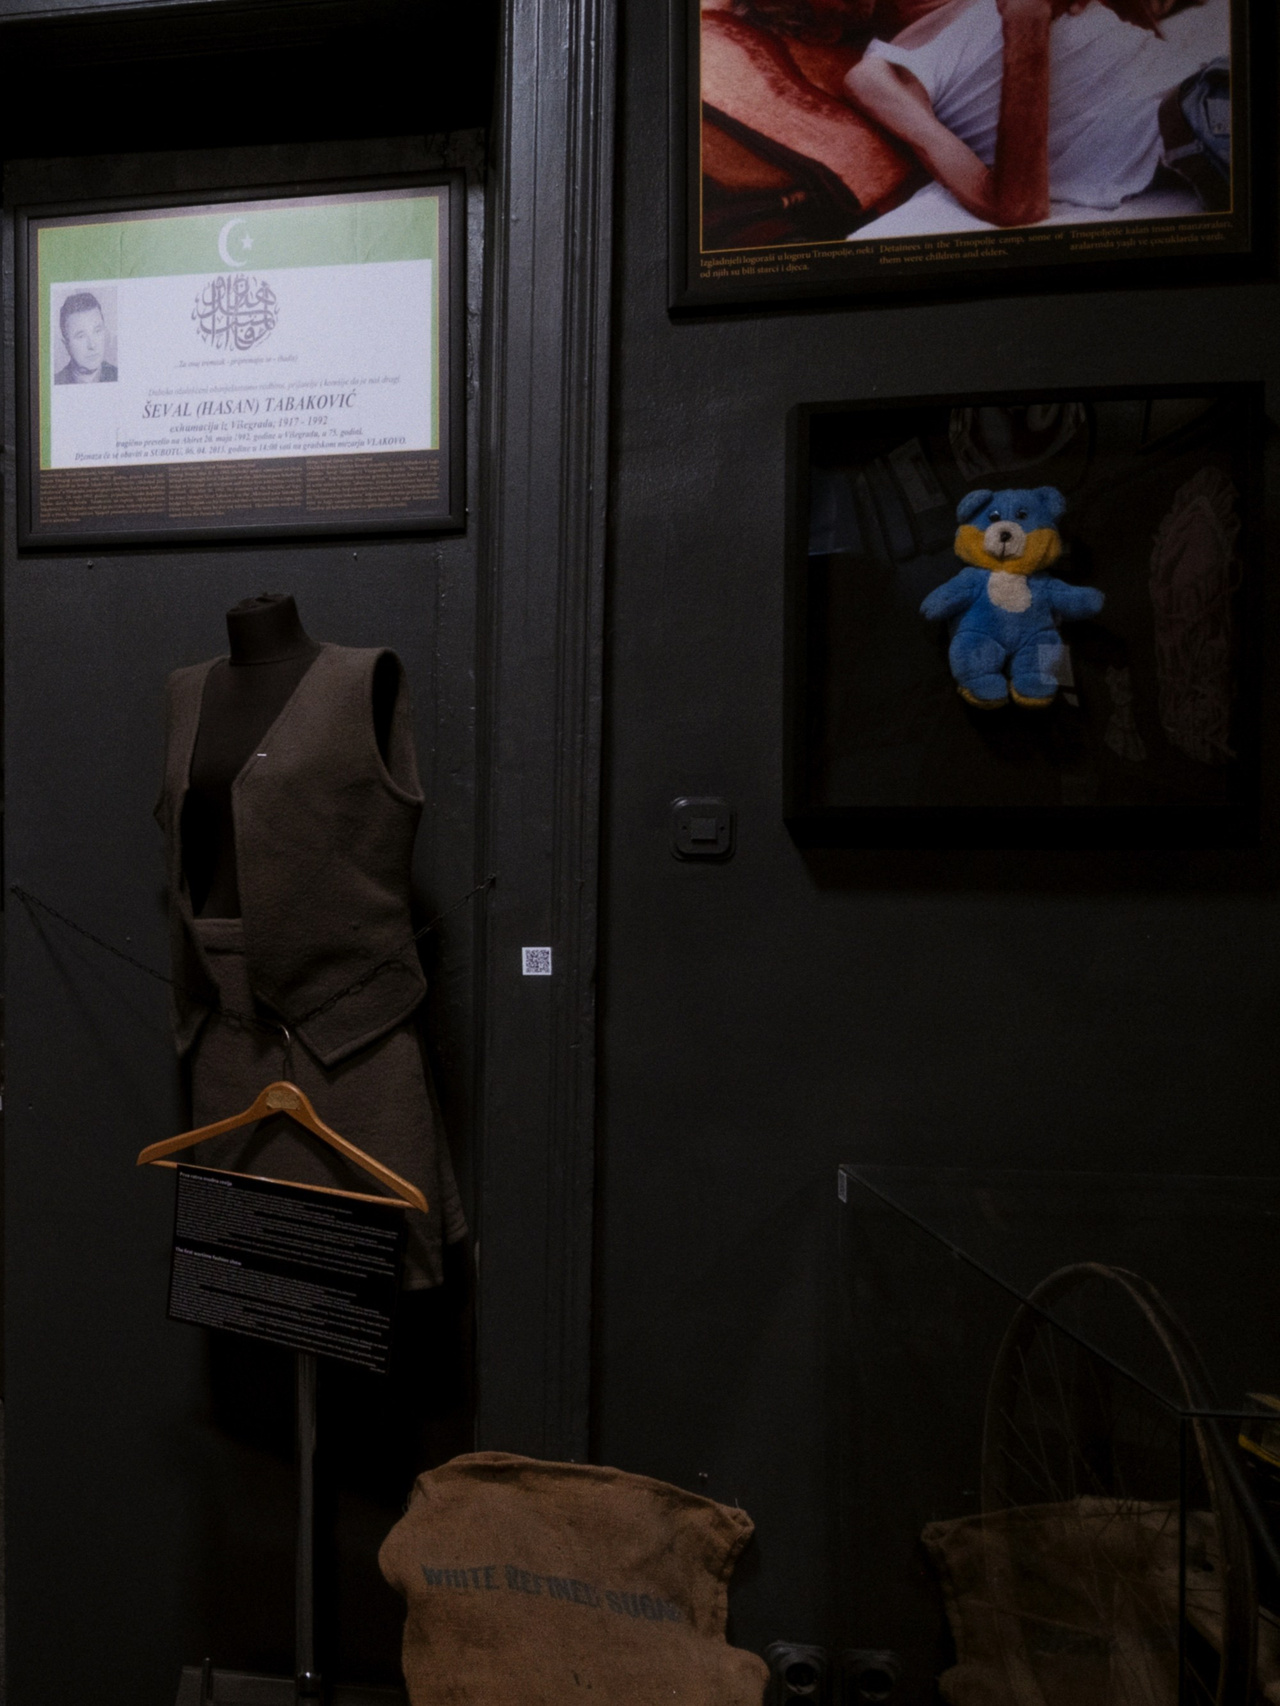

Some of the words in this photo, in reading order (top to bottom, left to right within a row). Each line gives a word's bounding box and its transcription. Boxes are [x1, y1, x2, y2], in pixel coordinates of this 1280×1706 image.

[880, 243, 921, 253] Detainees
[937, 240, 951, 249] the
[1028, 234, 1051, 243] some
[1054, 231, 1064, 240] of
[700, 256, 742, 268] Izgladnjeli
[784, 252, 810, 264] logoru
[856, 246, 874, 256] neki
[880, 255, 901, 265] them
[903, 254, 923, 262] were
[925, 252, 961, 261] children
[962, 248, 979, 258] and
[699, 270, 711, 278] od
[713, 267, 729, 279] njih
[742, 266, 756, 275] bili
[757, 265, 779, 274] starci
[142, 400, 192, 419] ŠEVAL
[196, 398, 260, 419] (HASAN)
[265, 389, 357, 413] TABAKOVIĆ
[169, 421, 219, 433] exhumacija
[220, 421, 228, 430] iz
[278, 416, 300, 427] 1917
[307, 415, 329, 426] 1992
[171, 437, 180, 445] na
[367, 436, 407, 447] VLAKOVO.
[421, 1563, 500, 1591] WHITE
